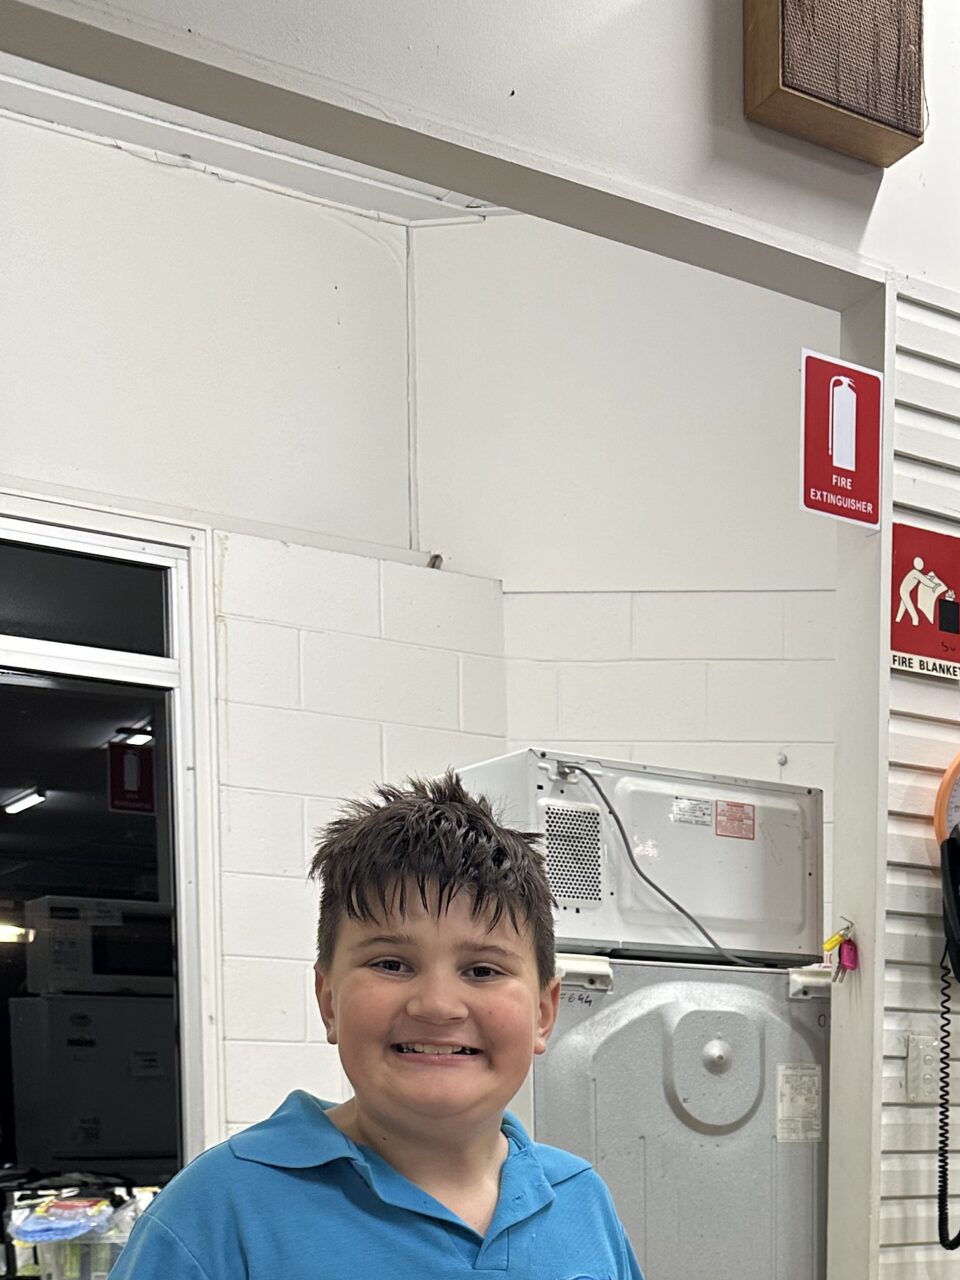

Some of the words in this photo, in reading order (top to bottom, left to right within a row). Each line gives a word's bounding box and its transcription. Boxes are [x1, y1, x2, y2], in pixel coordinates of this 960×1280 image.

[832, 474, 853, 490] FIRE
[810, 488, 873, 514] EXTINGUISHER
[892, 655, 914, 669] FIRE
